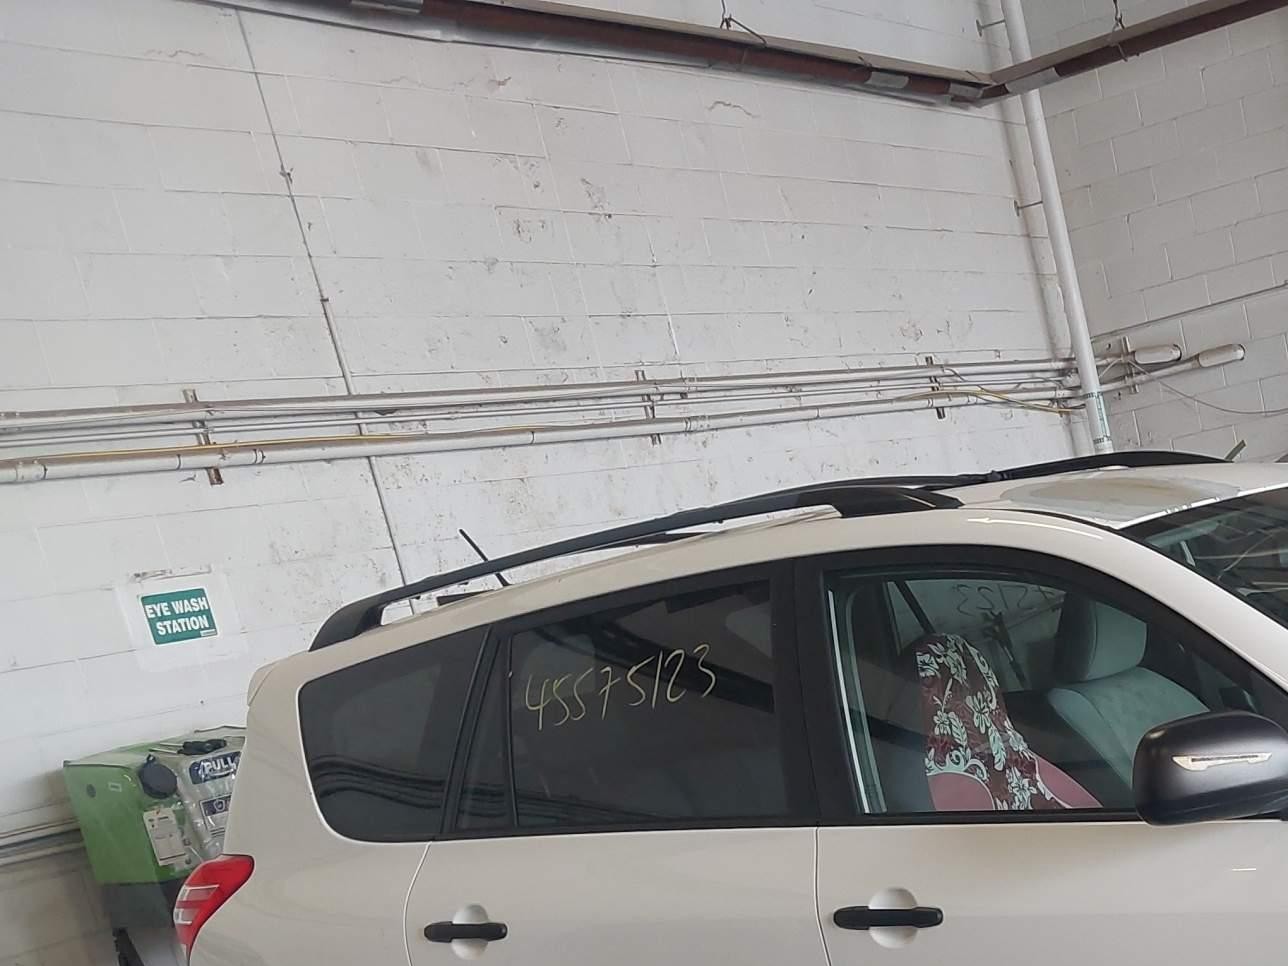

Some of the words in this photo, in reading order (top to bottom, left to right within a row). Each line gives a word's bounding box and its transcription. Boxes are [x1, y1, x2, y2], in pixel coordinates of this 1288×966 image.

[145, 602, 171, 619] EYE
[172, 597, 209, 615] WASH
[156, 615, 210, 636] STATION
[525, 643, 716, 731] 45575123
